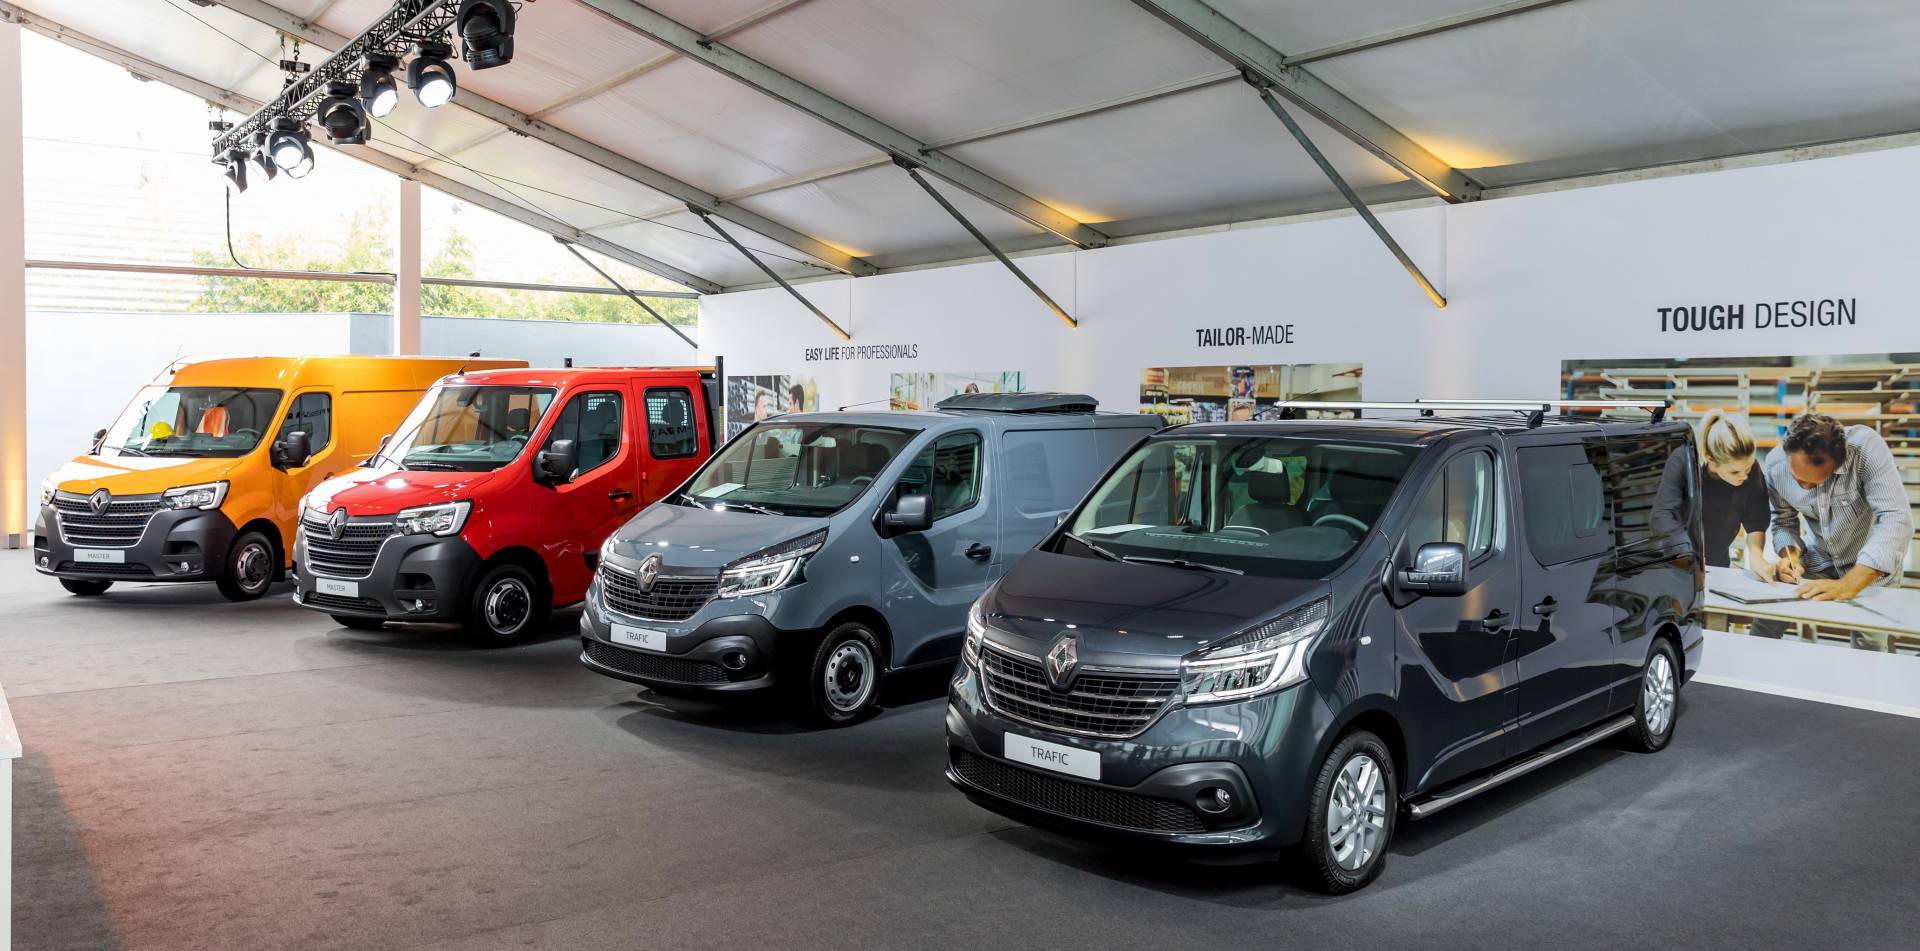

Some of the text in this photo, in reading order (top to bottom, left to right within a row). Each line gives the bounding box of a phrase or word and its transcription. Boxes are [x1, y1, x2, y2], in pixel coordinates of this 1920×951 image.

[1657, 298, 1856, 332] TOUGH DESIGN
[1196, 324, 1294, 347] TAILOR-MADE
[805, 343, 918, 361] EASY LIFE FOR PROFESSIONALS
[626, 631, 649, 644] TRAFIC
[1030, 746, 1070, 766] TRAFIC
